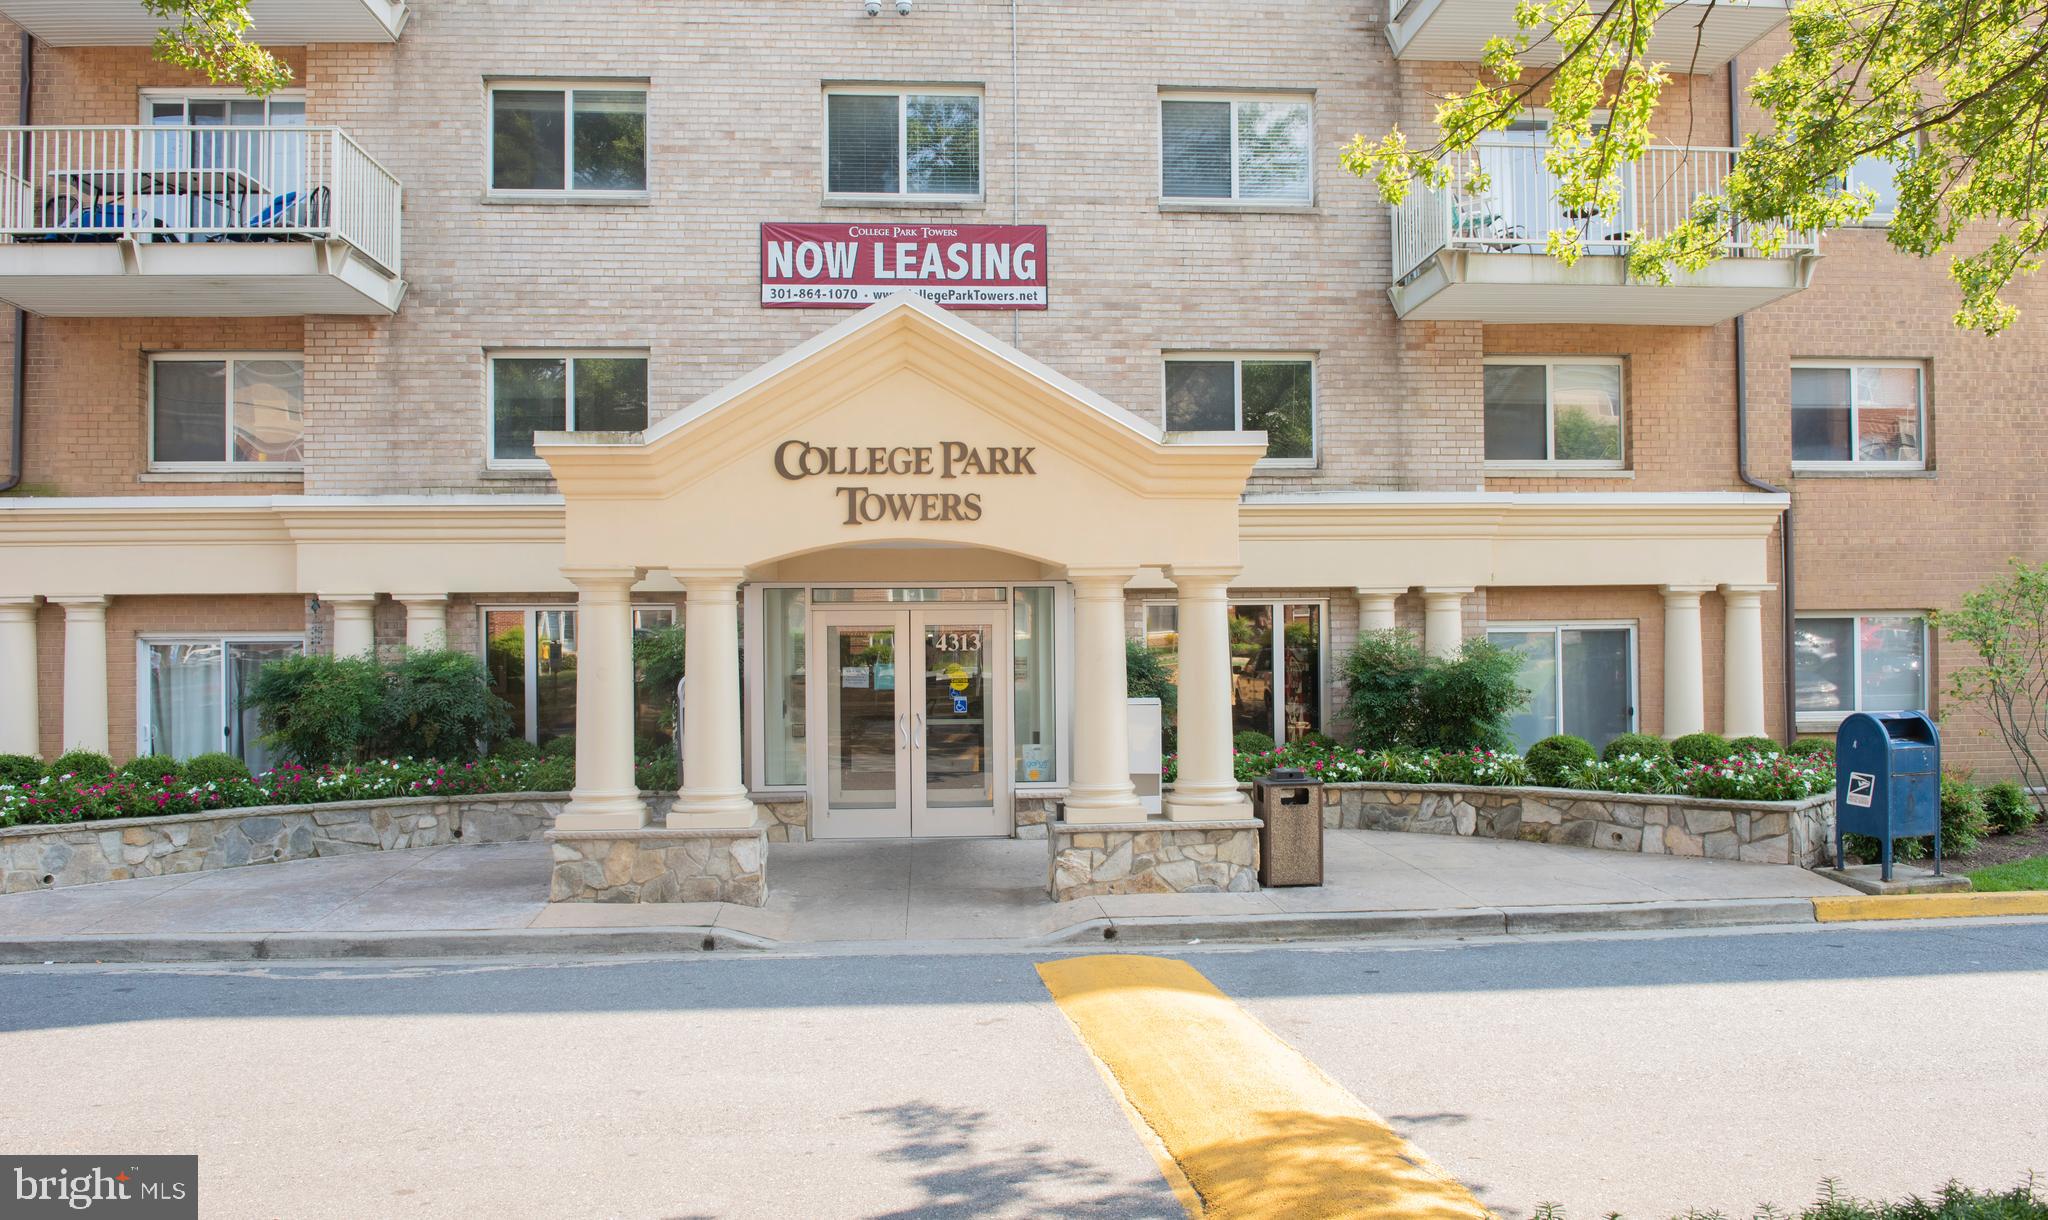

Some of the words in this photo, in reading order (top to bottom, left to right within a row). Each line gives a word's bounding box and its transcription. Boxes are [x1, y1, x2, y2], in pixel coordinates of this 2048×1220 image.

[848, 225, 890, 238] COLLEGE
[893, 226, 917, 238] PARK
[920, 227, 958, 239] TOWERS
[767, 241, 858, 279] NOW
[874, 242, 1036, 281] LEASING
[770, 288, 858, 300] 301-864-1070
[873, 288, 1038, 303] wwllegeParkTowers.net
[774, 440, 934, 480] COLLEGE
[939, 441, 1037, 479] PARK
[835, 486, 982, 526] TOWERS
[935, 633, 981, 652] 4313
